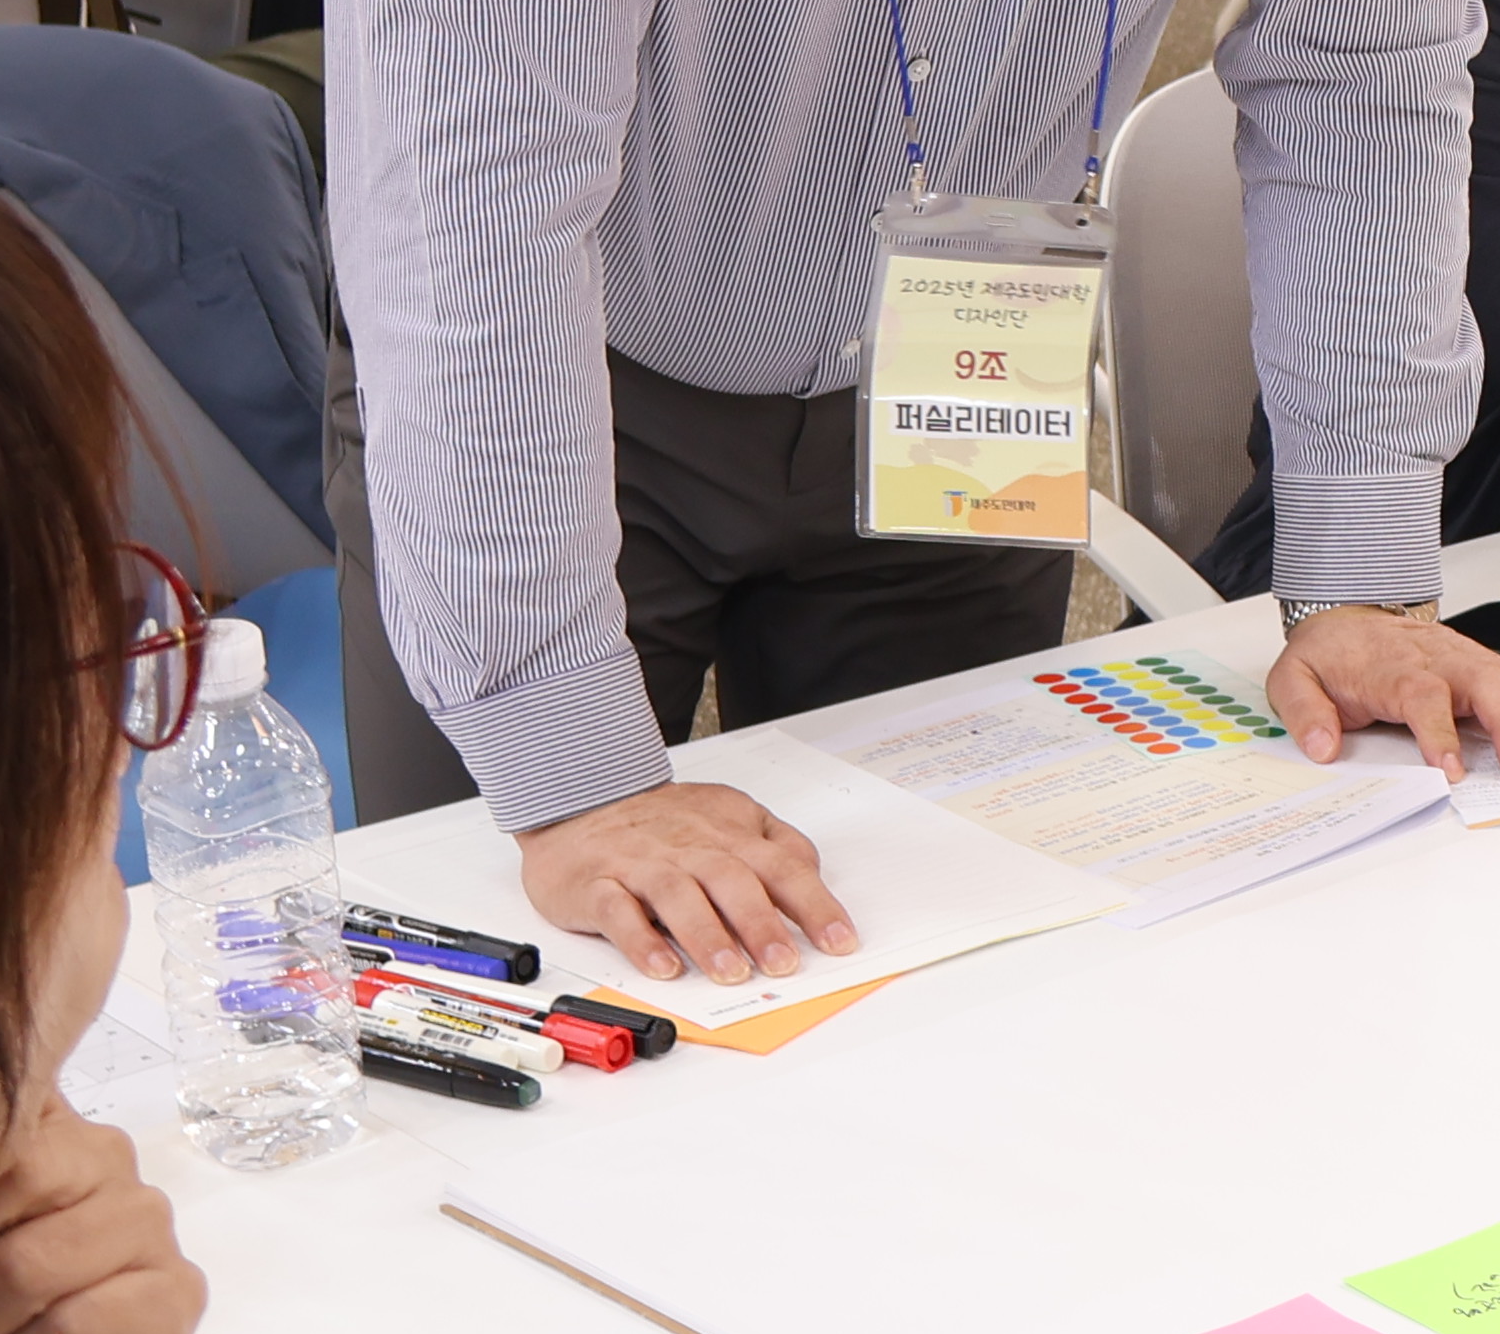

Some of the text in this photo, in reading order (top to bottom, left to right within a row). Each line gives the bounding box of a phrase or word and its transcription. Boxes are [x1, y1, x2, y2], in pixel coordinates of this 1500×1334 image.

[899, 277, 1092, 305] 2025년 제주도민대학
[954, 308, 1031, 329] 디자인단
[954, 350, 1008, 382] 9조
[894, 403, 1072, 437] 퍼실리테이터
